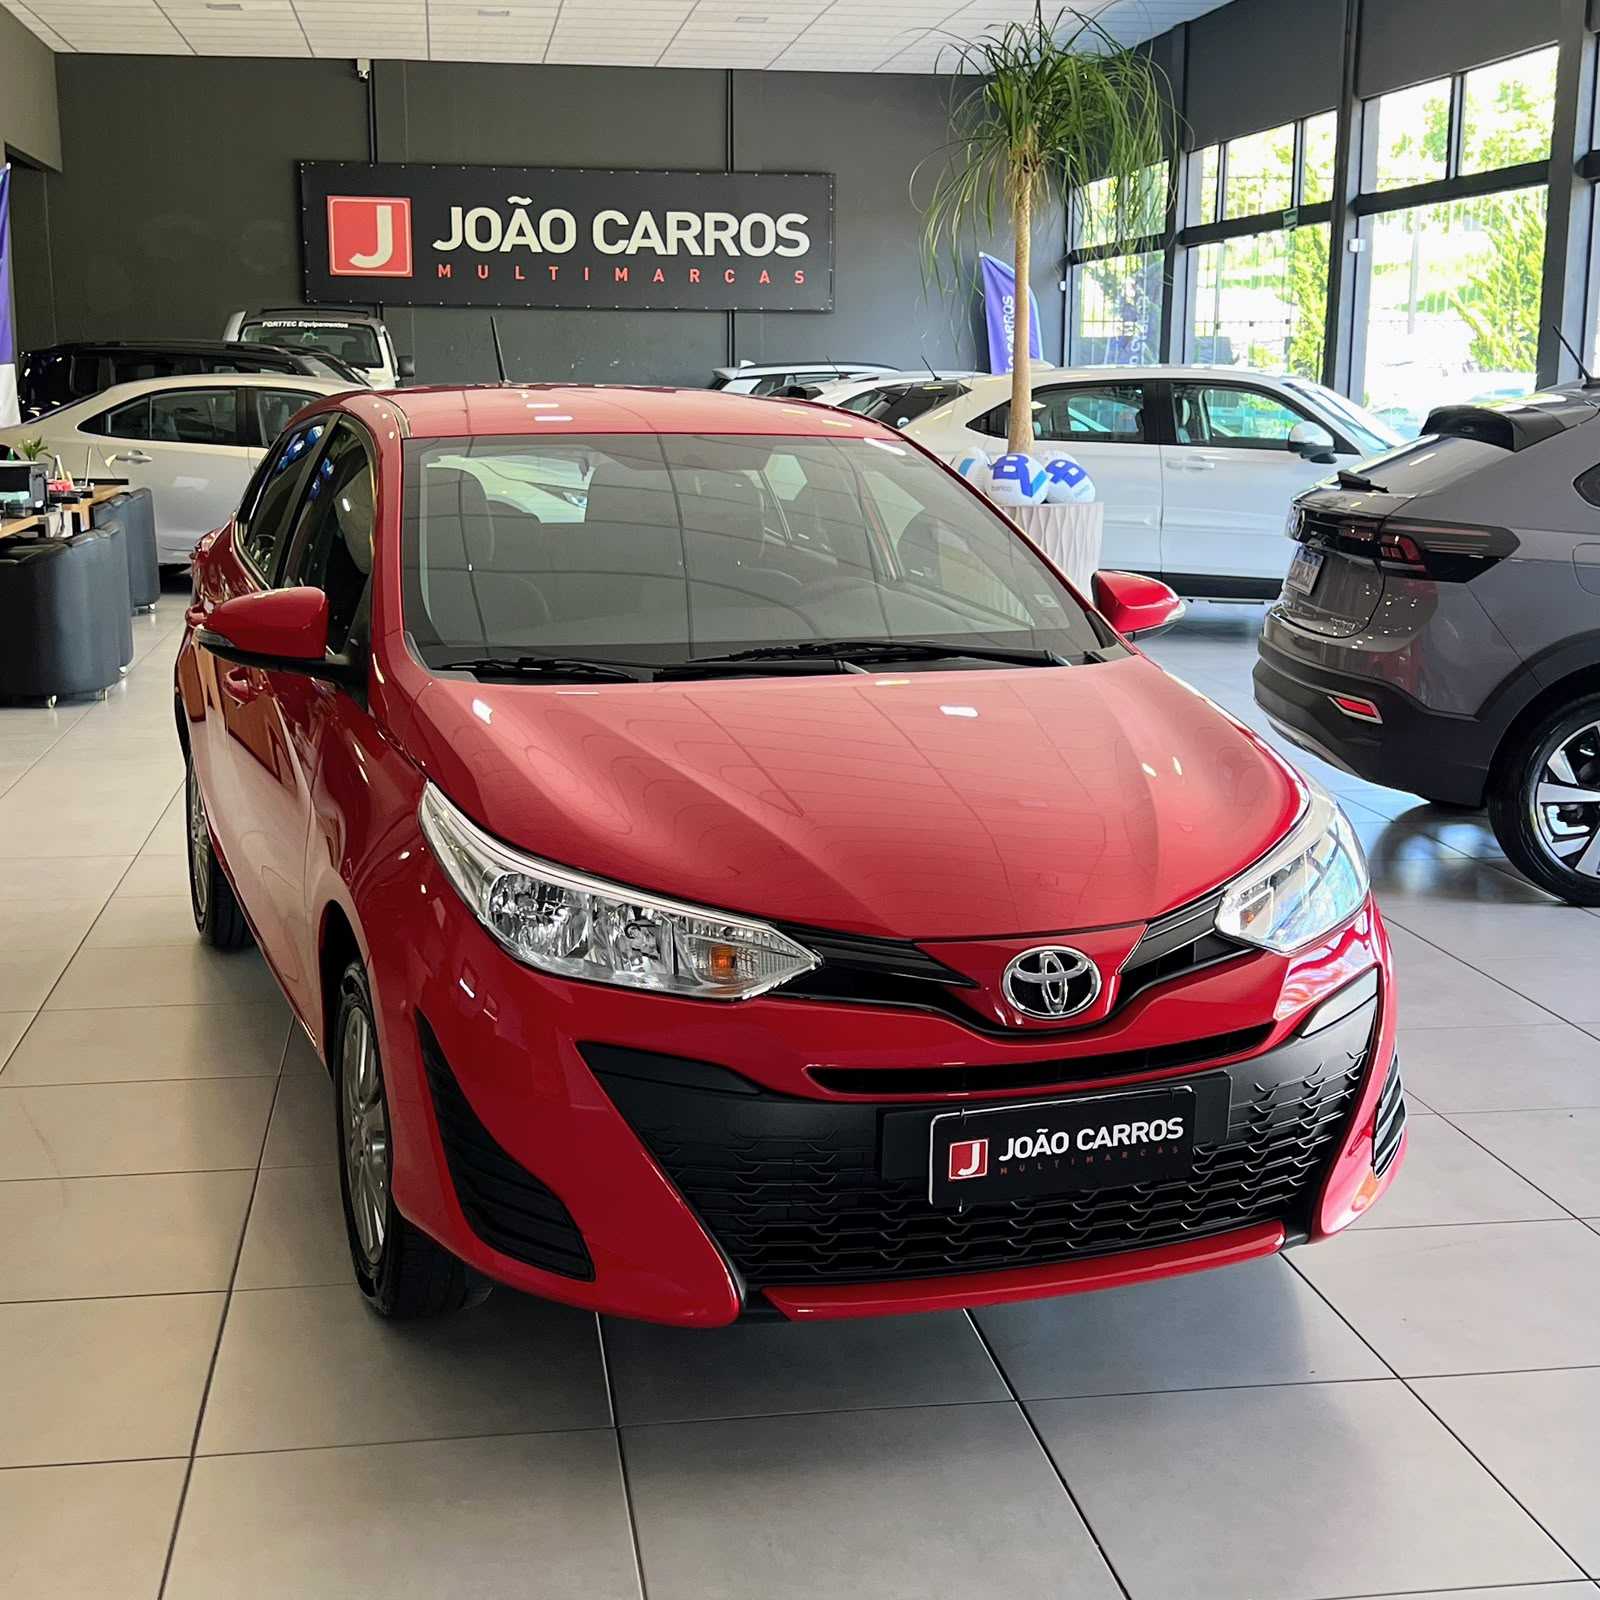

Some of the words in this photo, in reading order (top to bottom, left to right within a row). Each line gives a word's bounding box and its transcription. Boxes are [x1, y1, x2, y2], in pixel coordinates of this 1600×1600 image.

[432, 195, 577, 254] JOÃO
[592, 209, 811, 258] CARROS
[437, 264, 806, 285] MULTIMARCAS
[998, 1128, 1070, 1162] JOÃO
[1076, 1117, 1184, 1151] CARROS
